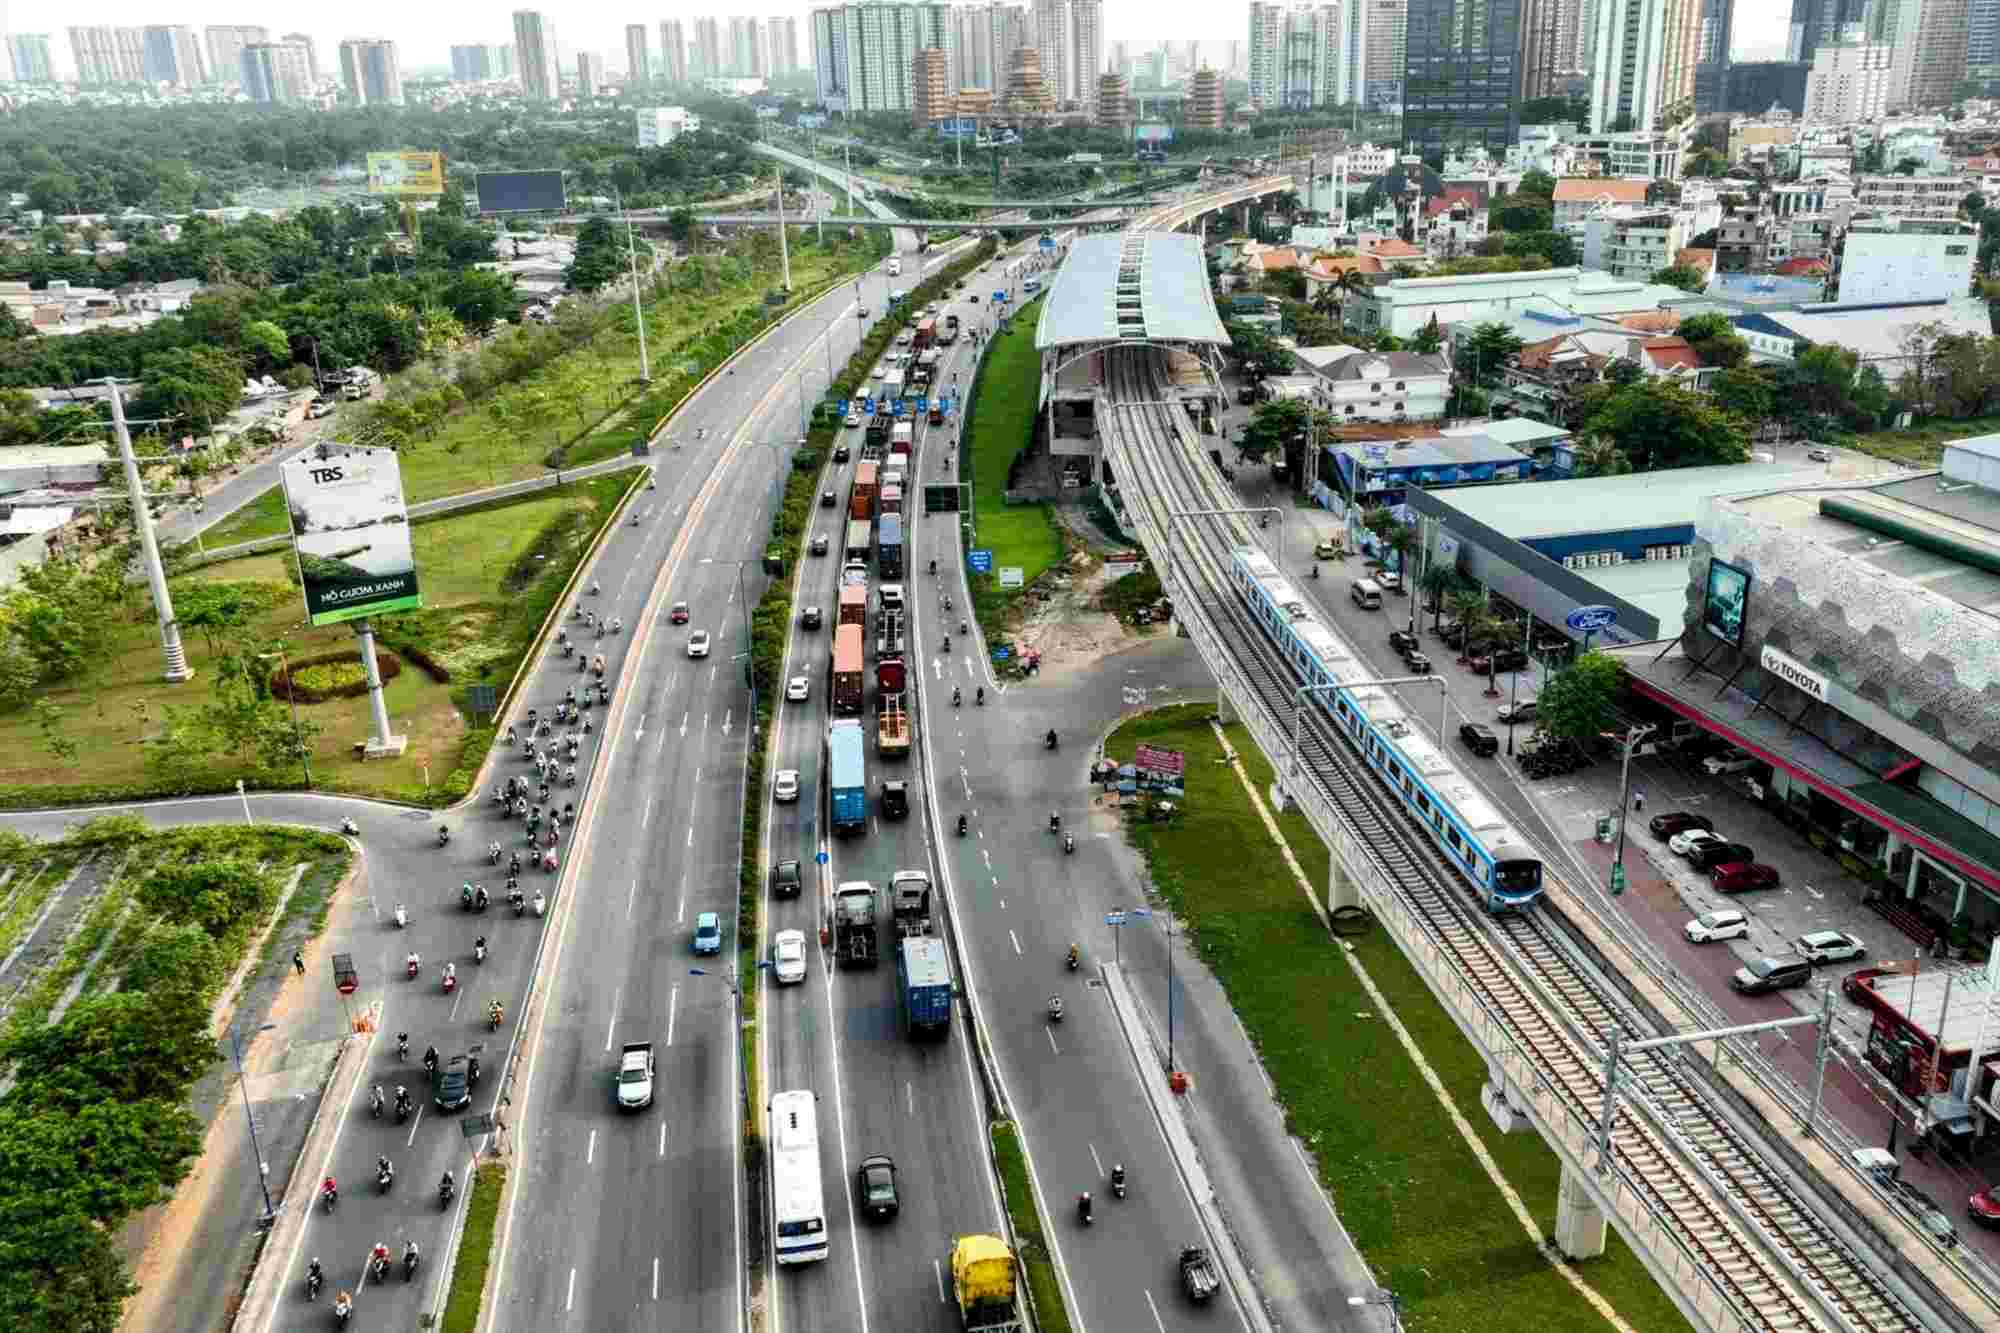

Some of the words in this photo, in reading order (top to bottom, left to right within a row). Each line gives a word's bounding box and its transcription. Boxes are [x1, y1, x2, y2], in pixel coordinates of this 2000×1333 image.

[309, 466, 344, 484] TBS
[375, 580, 405, 593] XANH
[1579, 612, 1610, 627] Ford
[1781, 662, 1821, 694] TOYOTA
